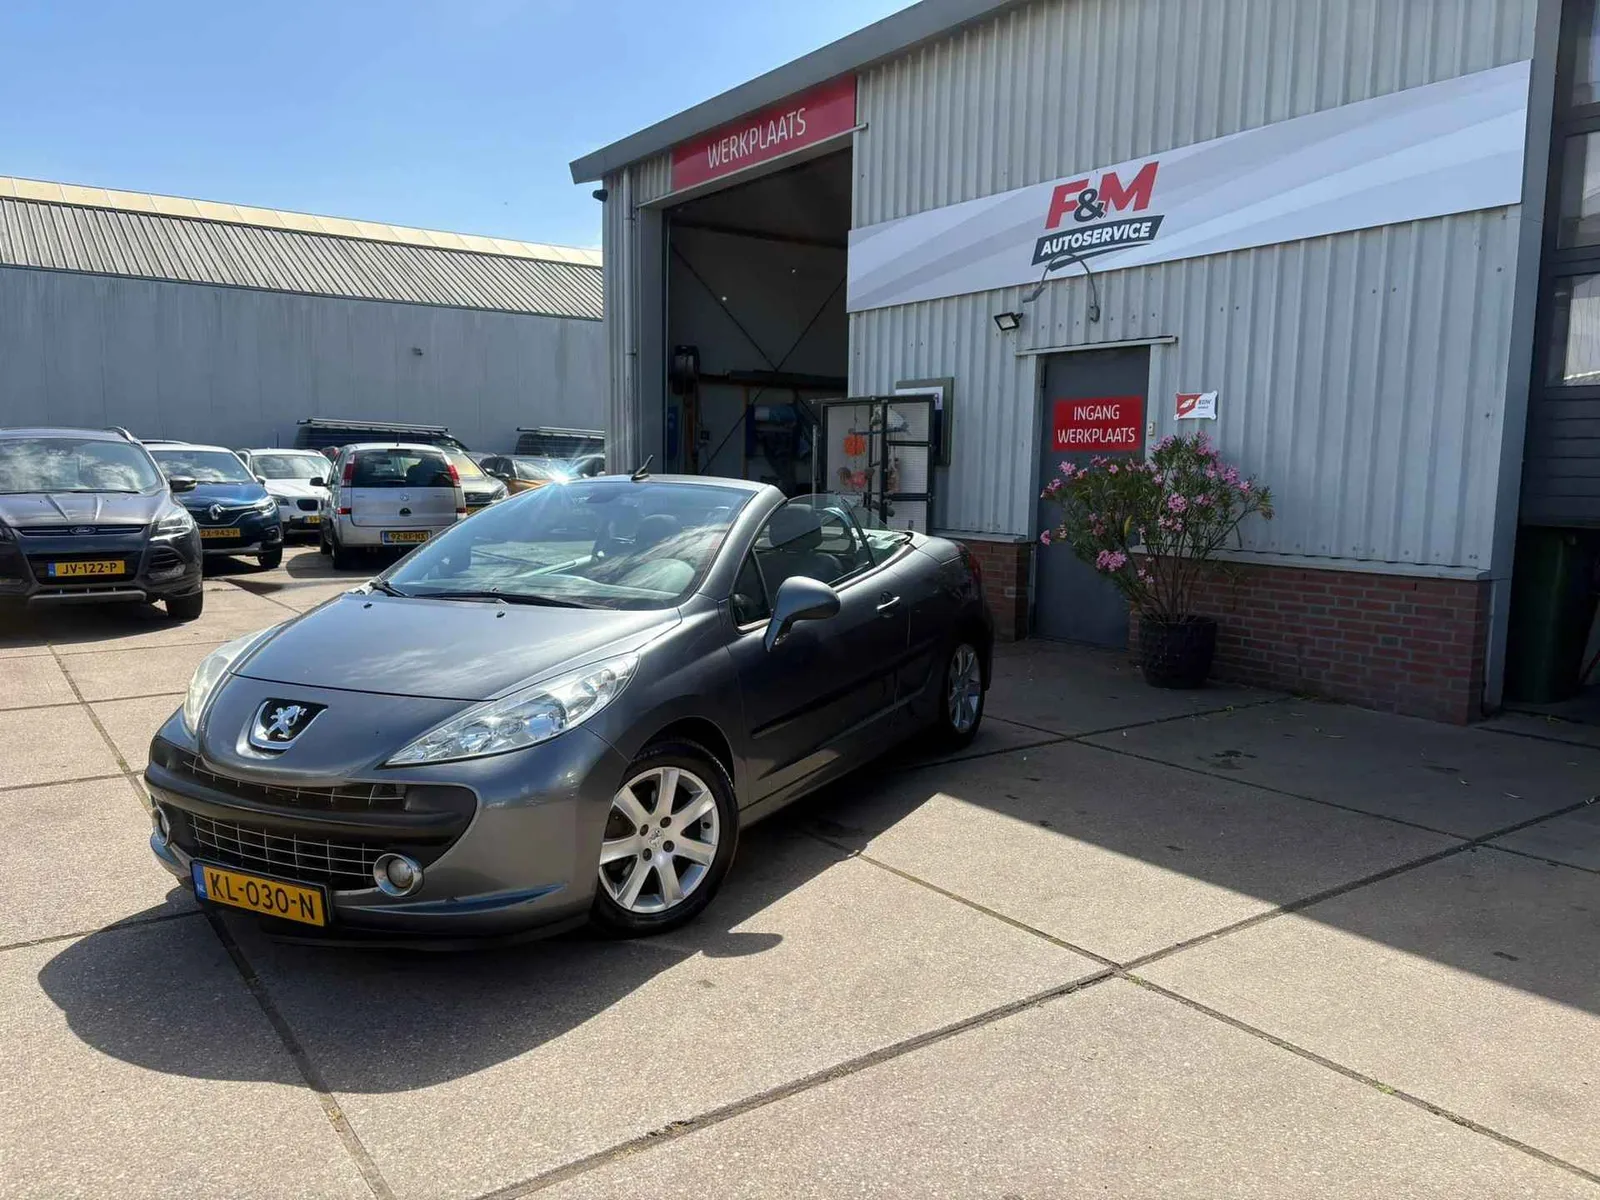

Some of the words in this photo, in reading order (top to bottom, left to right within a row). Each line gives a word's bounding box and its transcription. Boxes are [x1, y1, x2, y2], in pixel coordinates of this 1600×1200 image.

[707, 107, 807, 169] WERKPLAATS
[1045, 161, 1159, 230] F&M
[1040, 222, 1152, 256] AUTOSERVICE
[1073, 404, 1121, 421] INGANG
[1057, 427, 1136, 444] WERKPLAATS
[63, 562, 117, 575] JV-122-P
[210, 872, 315, 920] KL-030-N
